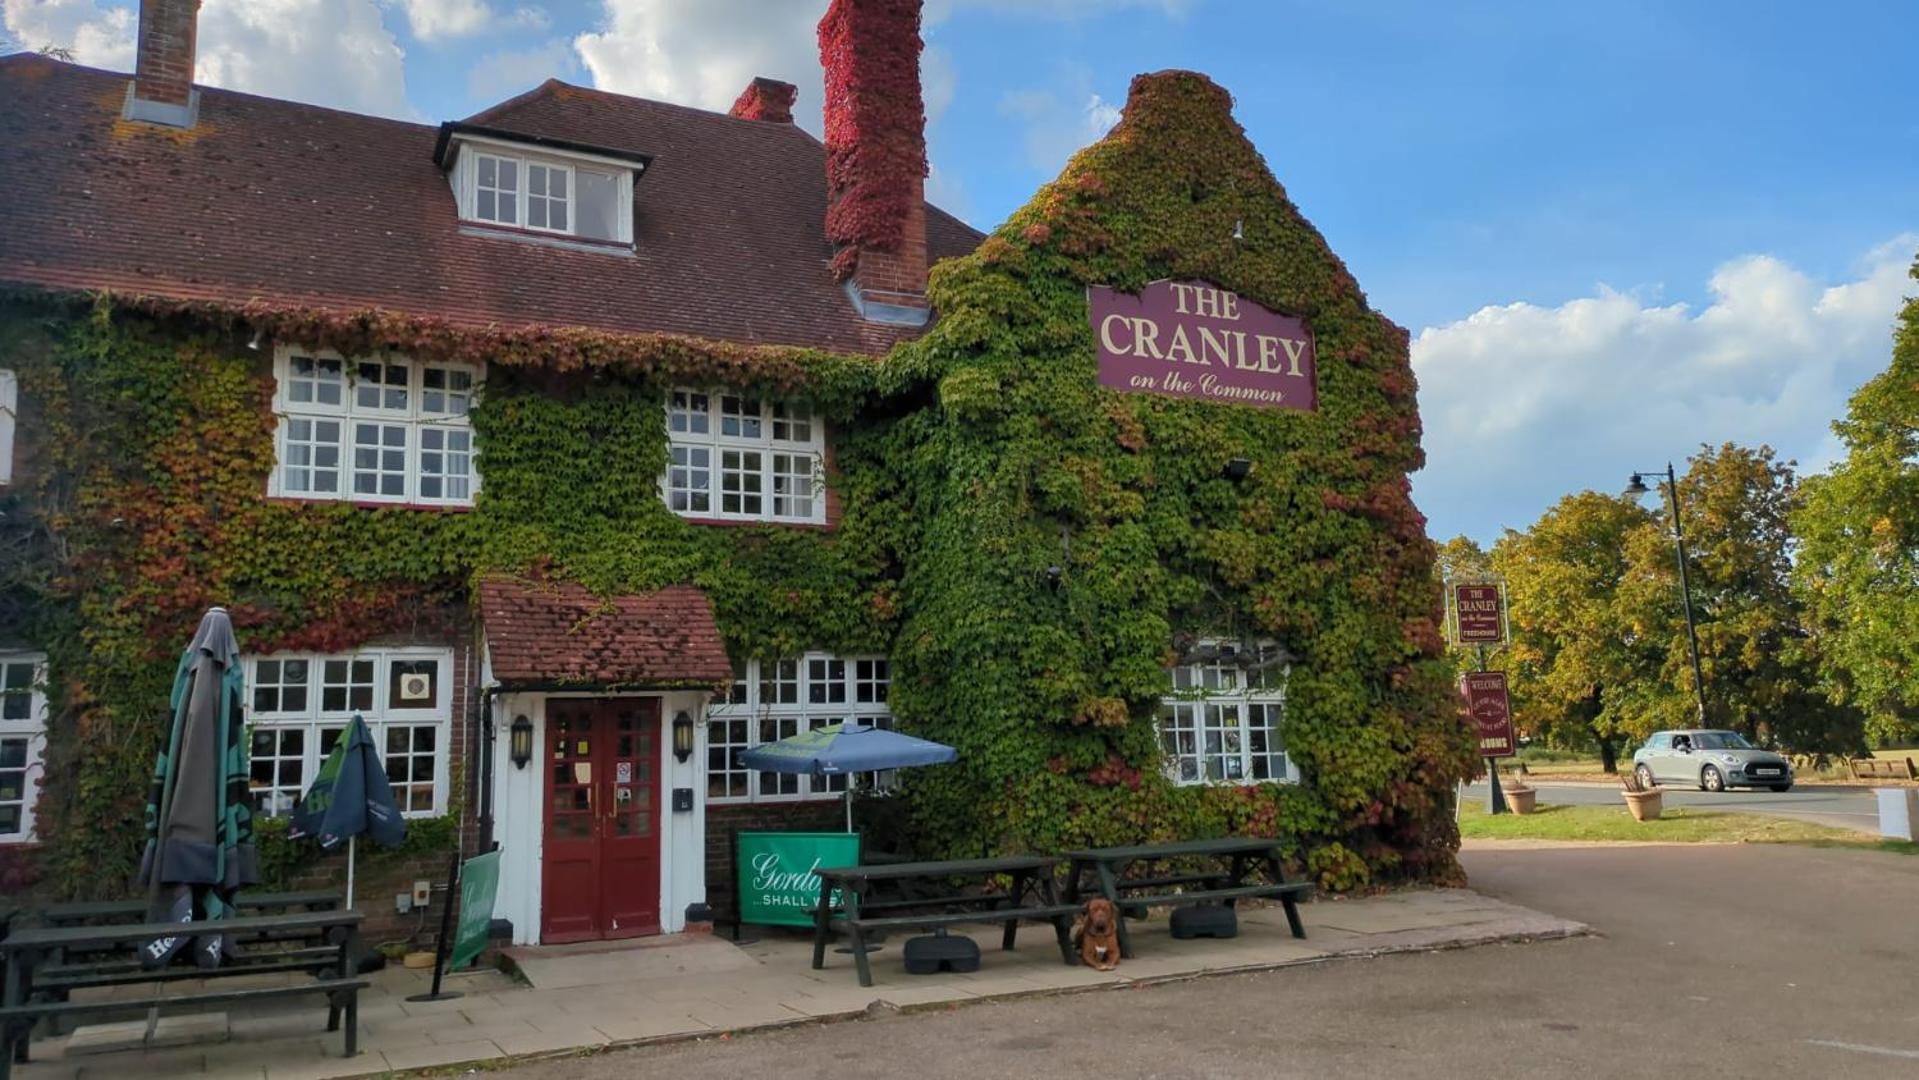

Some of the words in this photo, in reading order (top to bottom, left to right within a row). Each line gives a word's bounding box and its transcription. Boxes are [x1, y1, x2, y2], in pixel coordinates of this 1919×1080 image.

[1169, 282, 1241, 321] THE
[1101, 314, 1307, 377] CRANLEY
[1130, 374, 1156, 389] on
[1163, 371, 1196, 393] the
[1199, 373, 1287, 403] Common
[1459, 600, 1496, 611] CRANLEY
[1470, 590, 1482, 599] THE
[763, 894, 808, 907] SHALL
